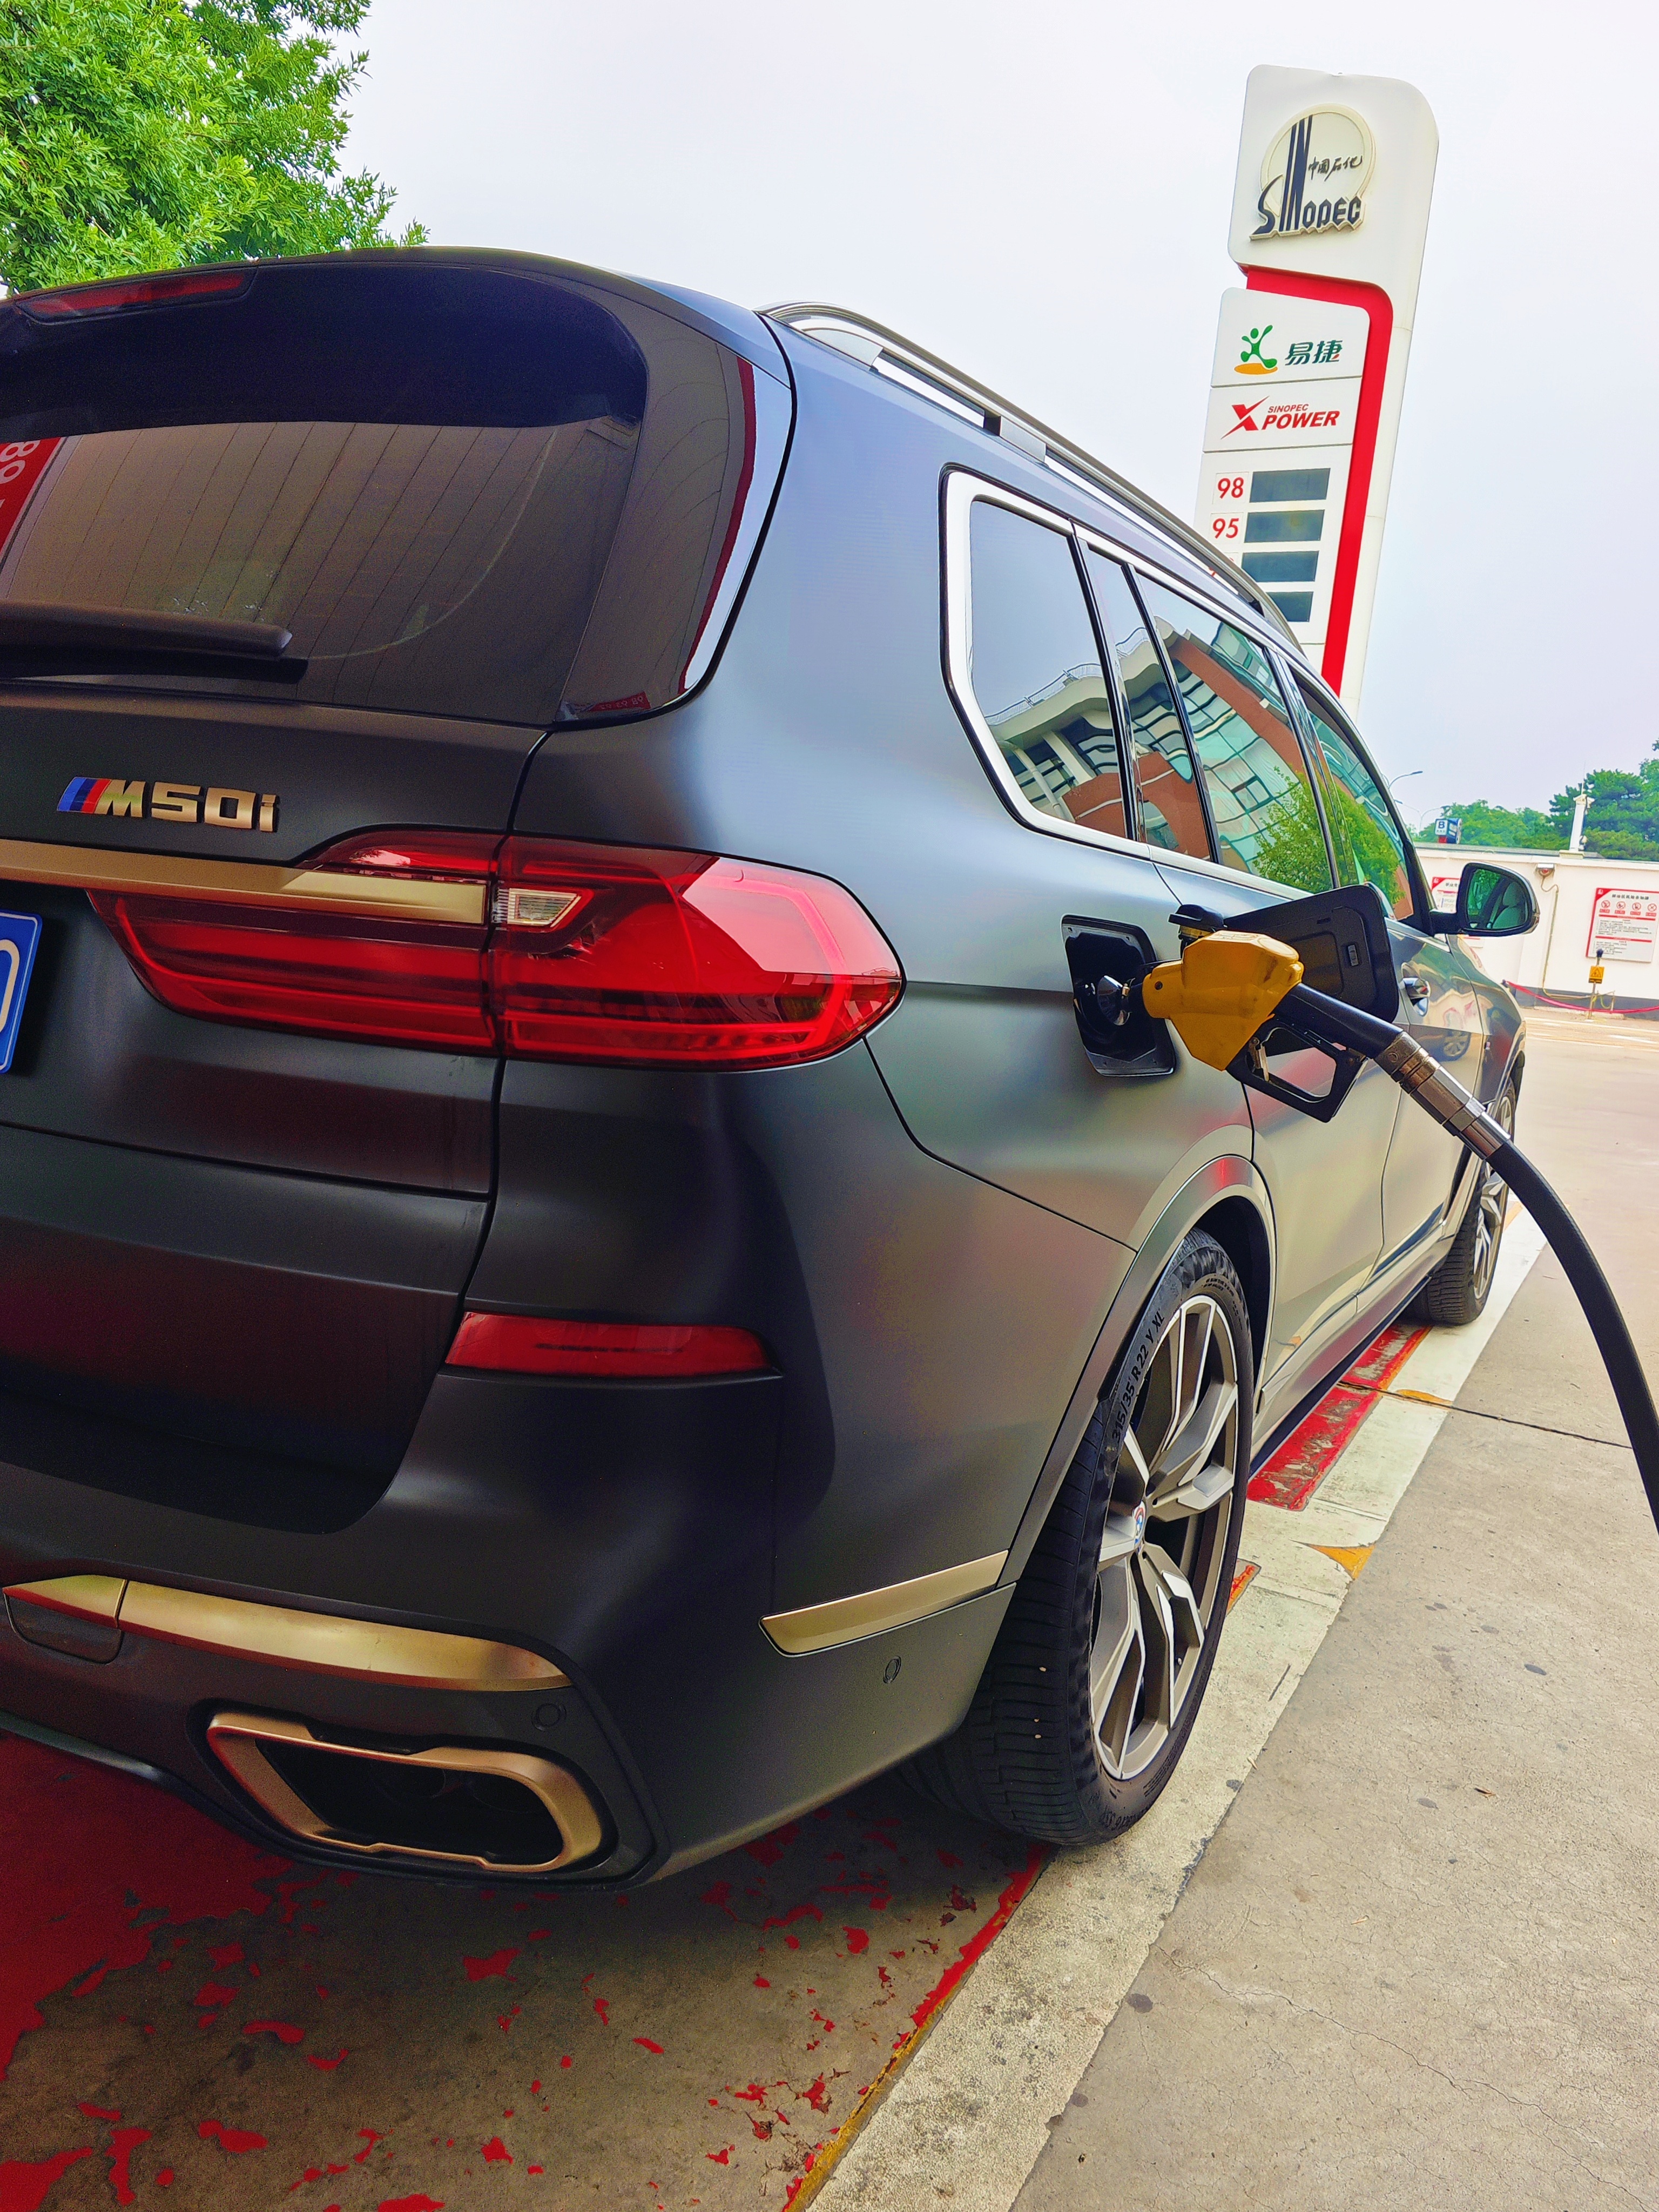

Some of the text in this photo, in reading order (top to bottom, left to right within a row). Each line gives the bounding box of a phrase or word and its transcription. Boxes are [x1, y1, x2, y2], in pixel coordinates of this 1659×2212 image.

[1252, 114, 1361, 234] SINOPEC
[1308, 156, 1363, 181] 中国石化
[1285, 340, 1343, 366] 易捷
[1262, 410, 1340, 430] POWER
[1267, 403, 1309, 413] SINOPEC
[1217, 477, 1244, 499] 98
[1212, 517, 1239, 539] 95
[93, 779, 277, 832] M50i
[1112, 1384, 1135, 1443] 315/35
[1152, 1311, 1164, 1333] XL
